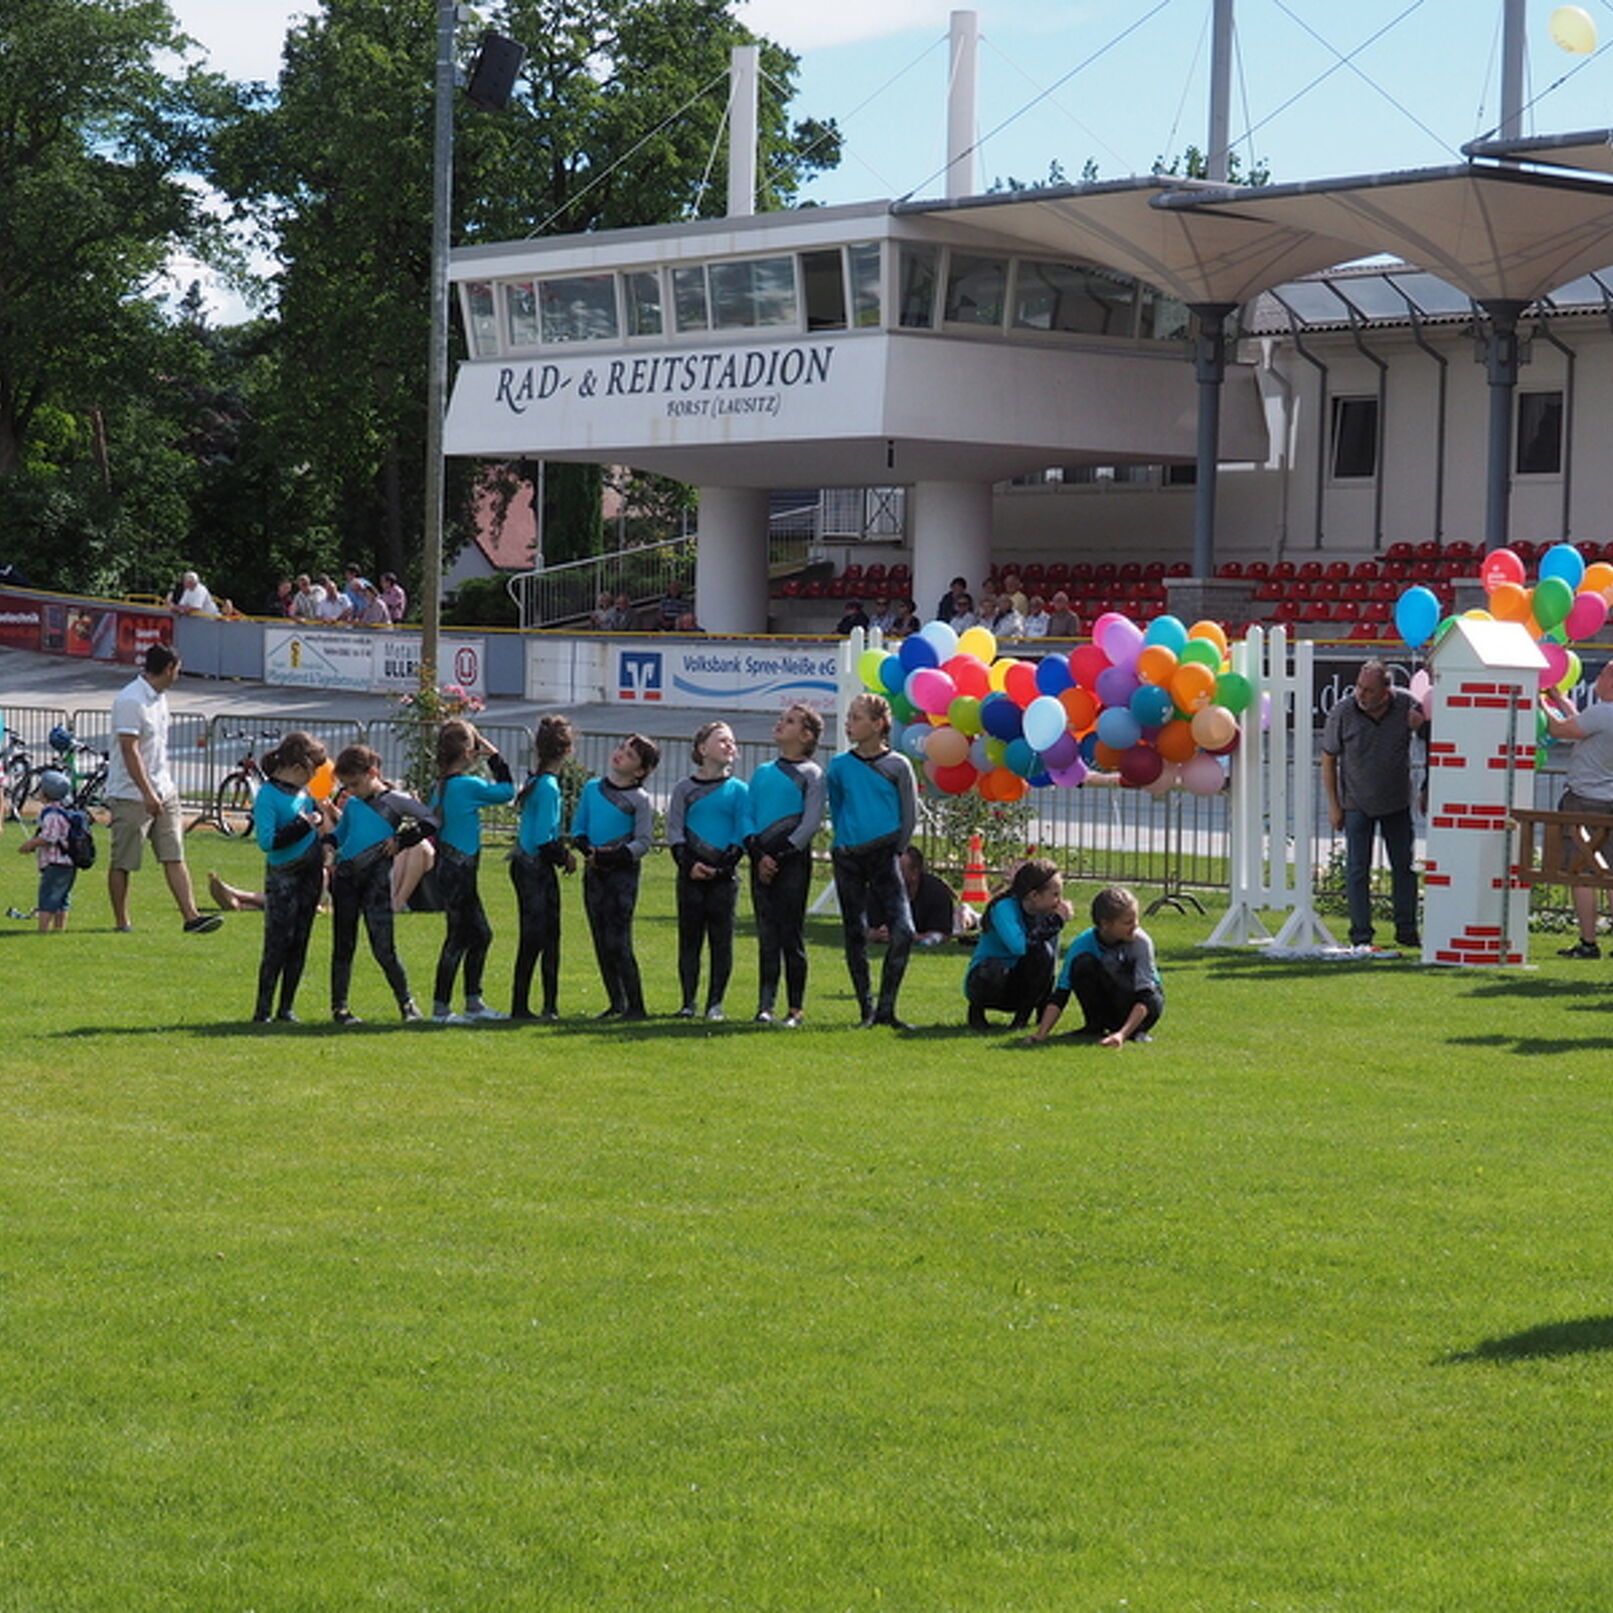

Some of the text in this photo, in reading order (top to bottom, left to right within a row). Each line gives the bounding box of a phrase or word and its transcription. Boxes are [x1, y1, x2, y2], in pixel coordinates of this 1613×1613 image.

[495, 345, 834, 414] RAD- & REITSTADION
[667, 392, 781, 419] FORST (LAUSITZ)
[385, 660, 420, 679] ULLR
[683, 655, 837, 677] Volksbank Spree-Neiße eG
